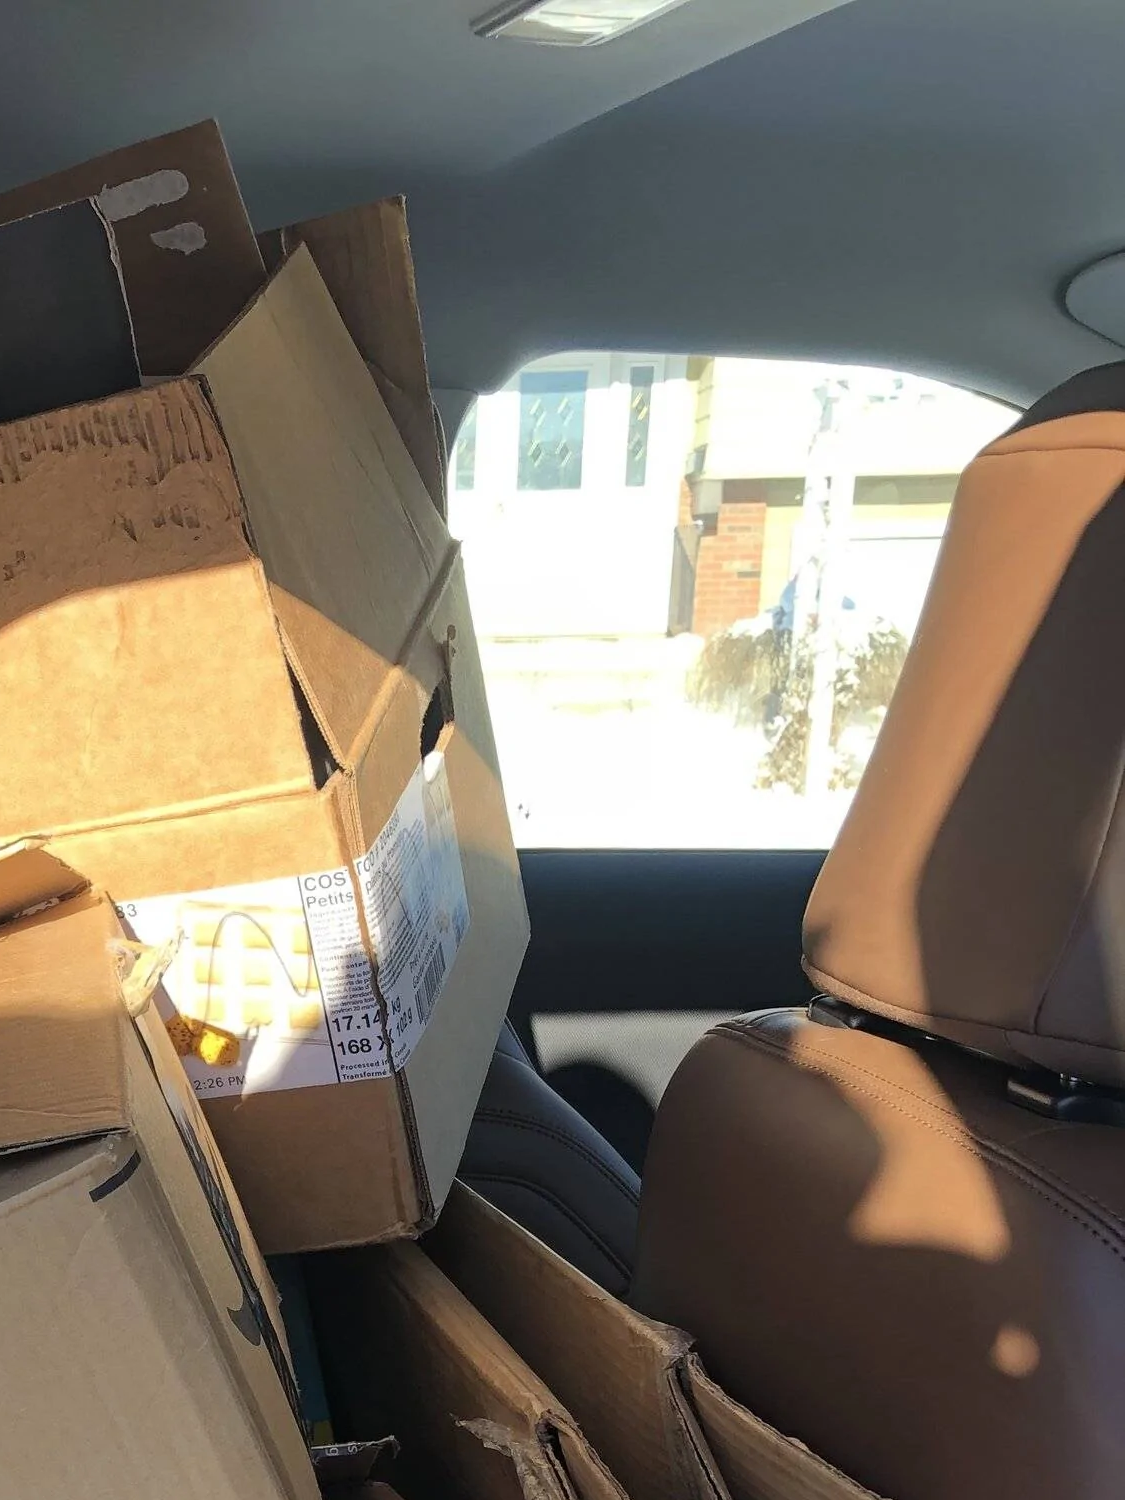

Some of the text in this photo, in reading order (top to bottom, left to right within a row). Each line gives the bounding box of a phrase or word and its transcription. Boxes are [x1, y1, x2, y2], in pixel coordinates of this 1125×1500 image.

[306, 891, 353, 909] Petits
[332, 1009, 386, 1033] 17.14
[337, 1038, 372, 1056] 168
[340, 1060, 380, 1071] Processed
[342, 1068, 387, 1081] Transformé
